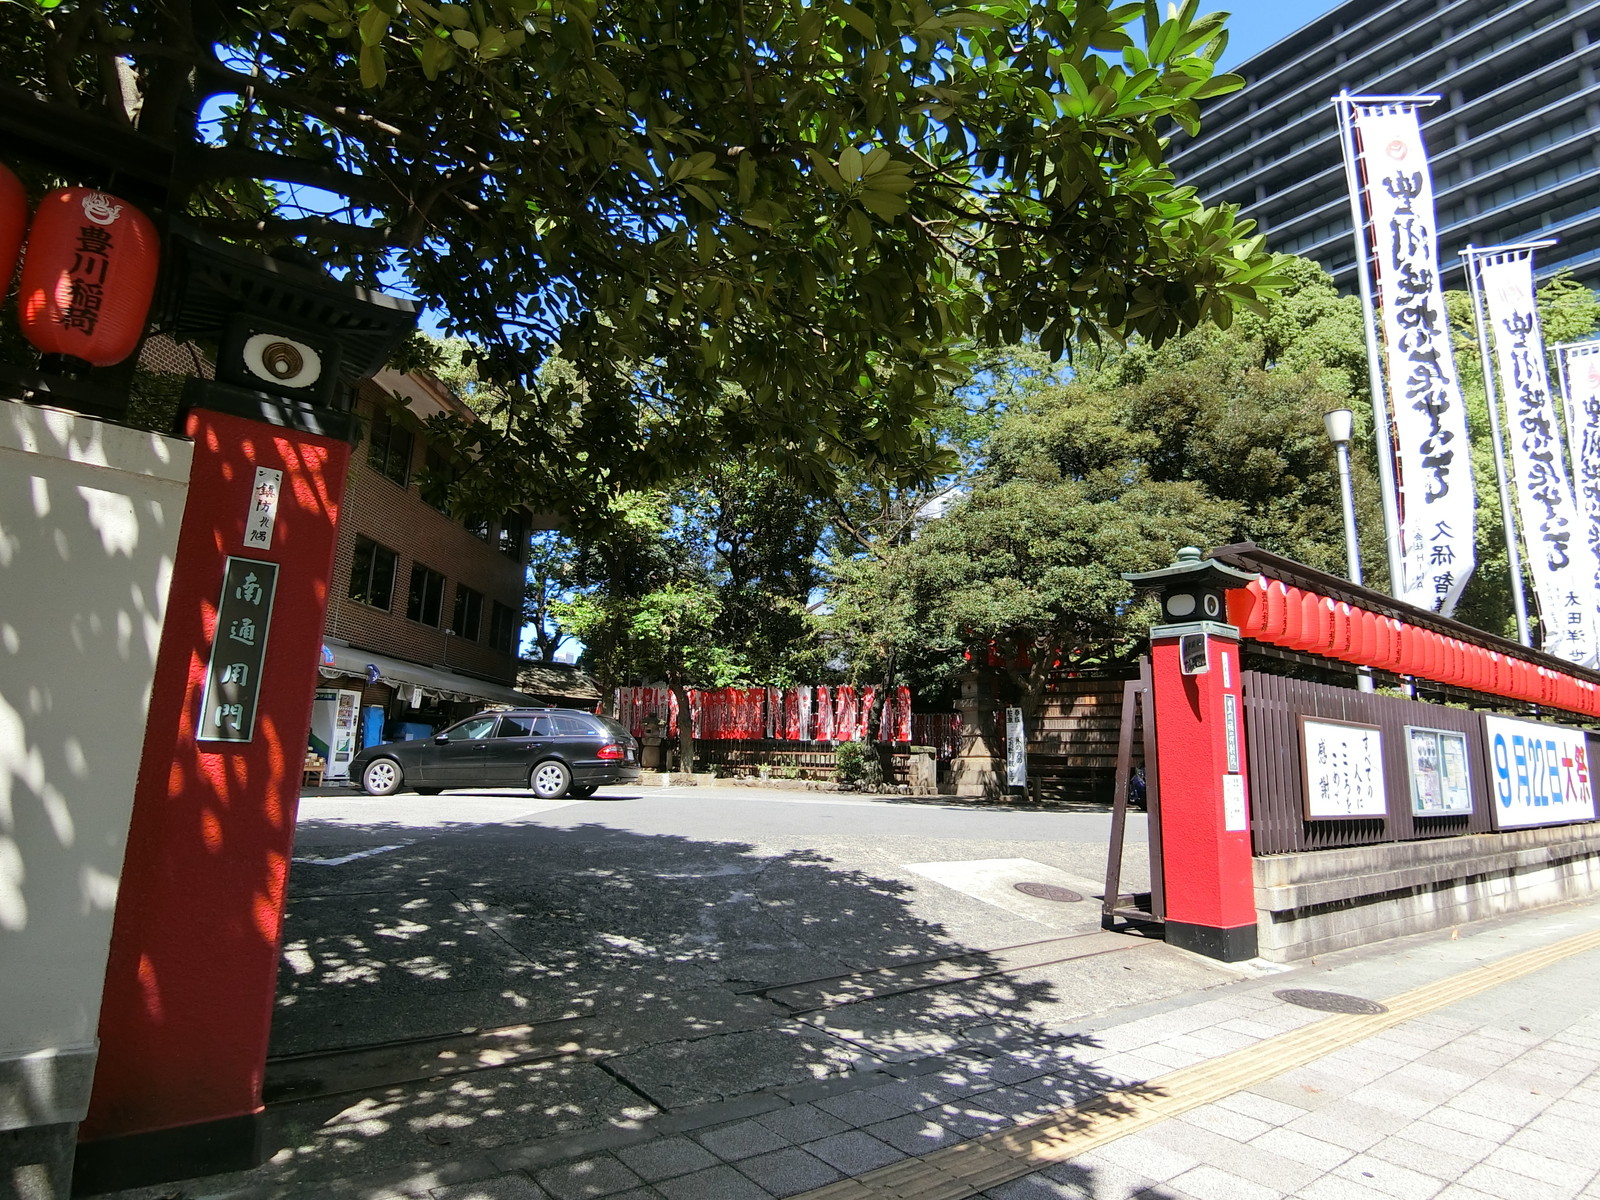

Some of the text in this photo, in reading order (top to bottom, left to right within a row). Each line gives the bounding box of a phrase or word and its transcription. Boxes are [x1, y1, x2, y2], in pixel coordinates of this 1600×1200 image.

[60, 225, 114, 336] 豊川稲荷
[214, 571, 263, 731] 南通用門
